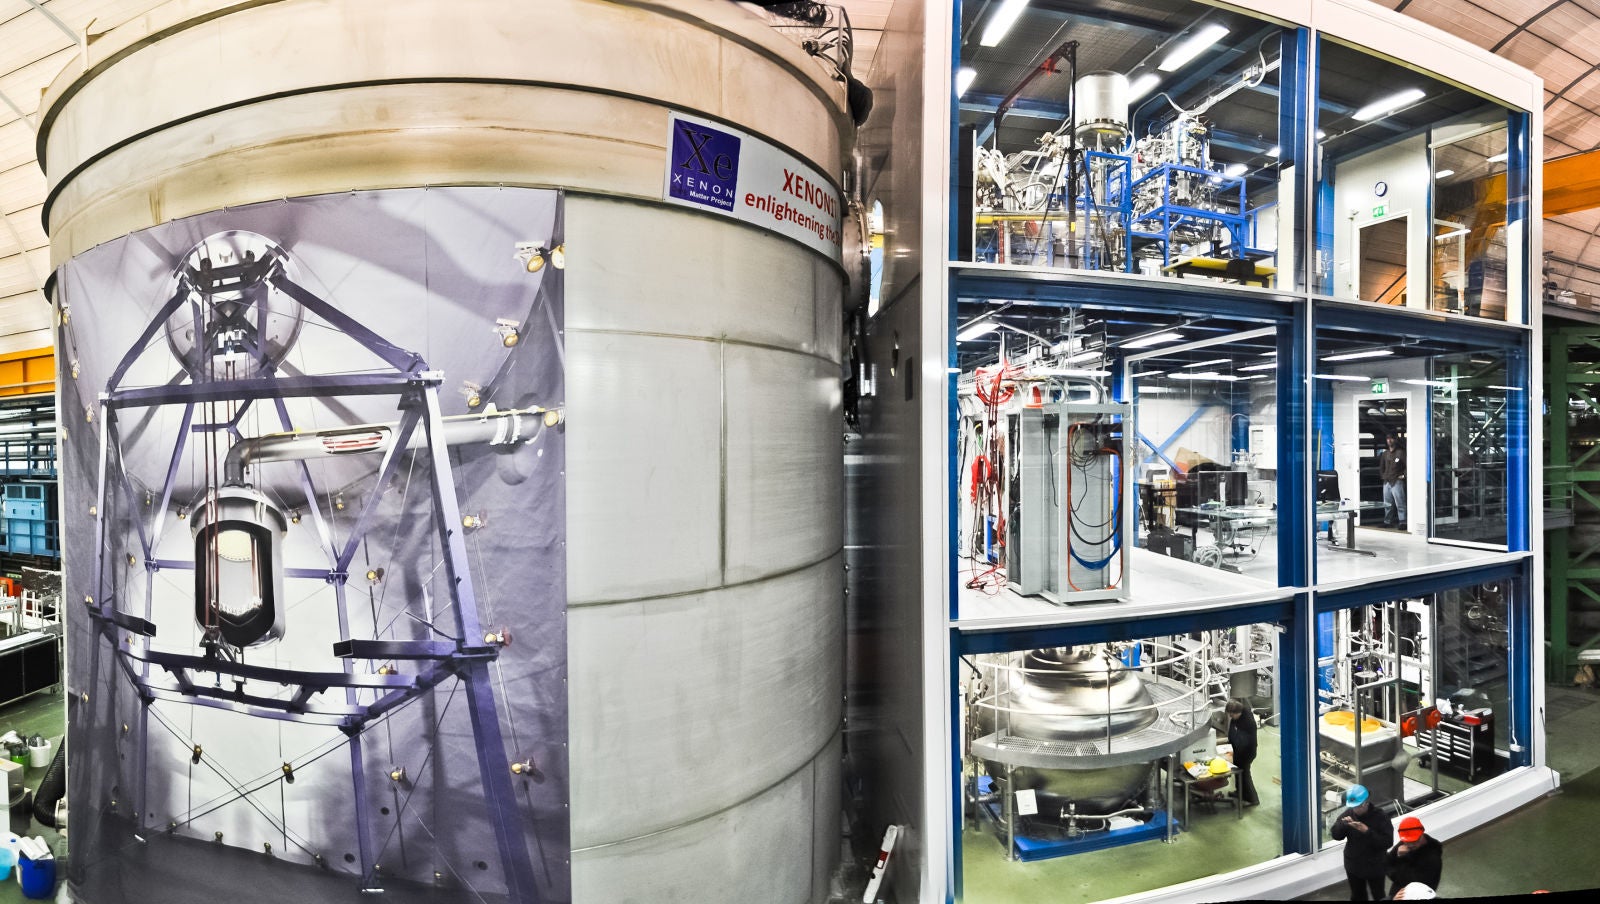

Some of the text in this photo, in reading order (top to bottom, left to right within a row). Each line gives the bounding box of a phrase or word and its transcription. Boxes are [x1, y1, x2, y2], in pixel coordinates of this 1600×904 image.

[680, 128, 733, 181] Xe
[673, 173, 733, 198] XENON
[690, 190, 710, 201] Matter
[711, 196, 732, 207] Project
[745, 192, 825, 240] enlightening
